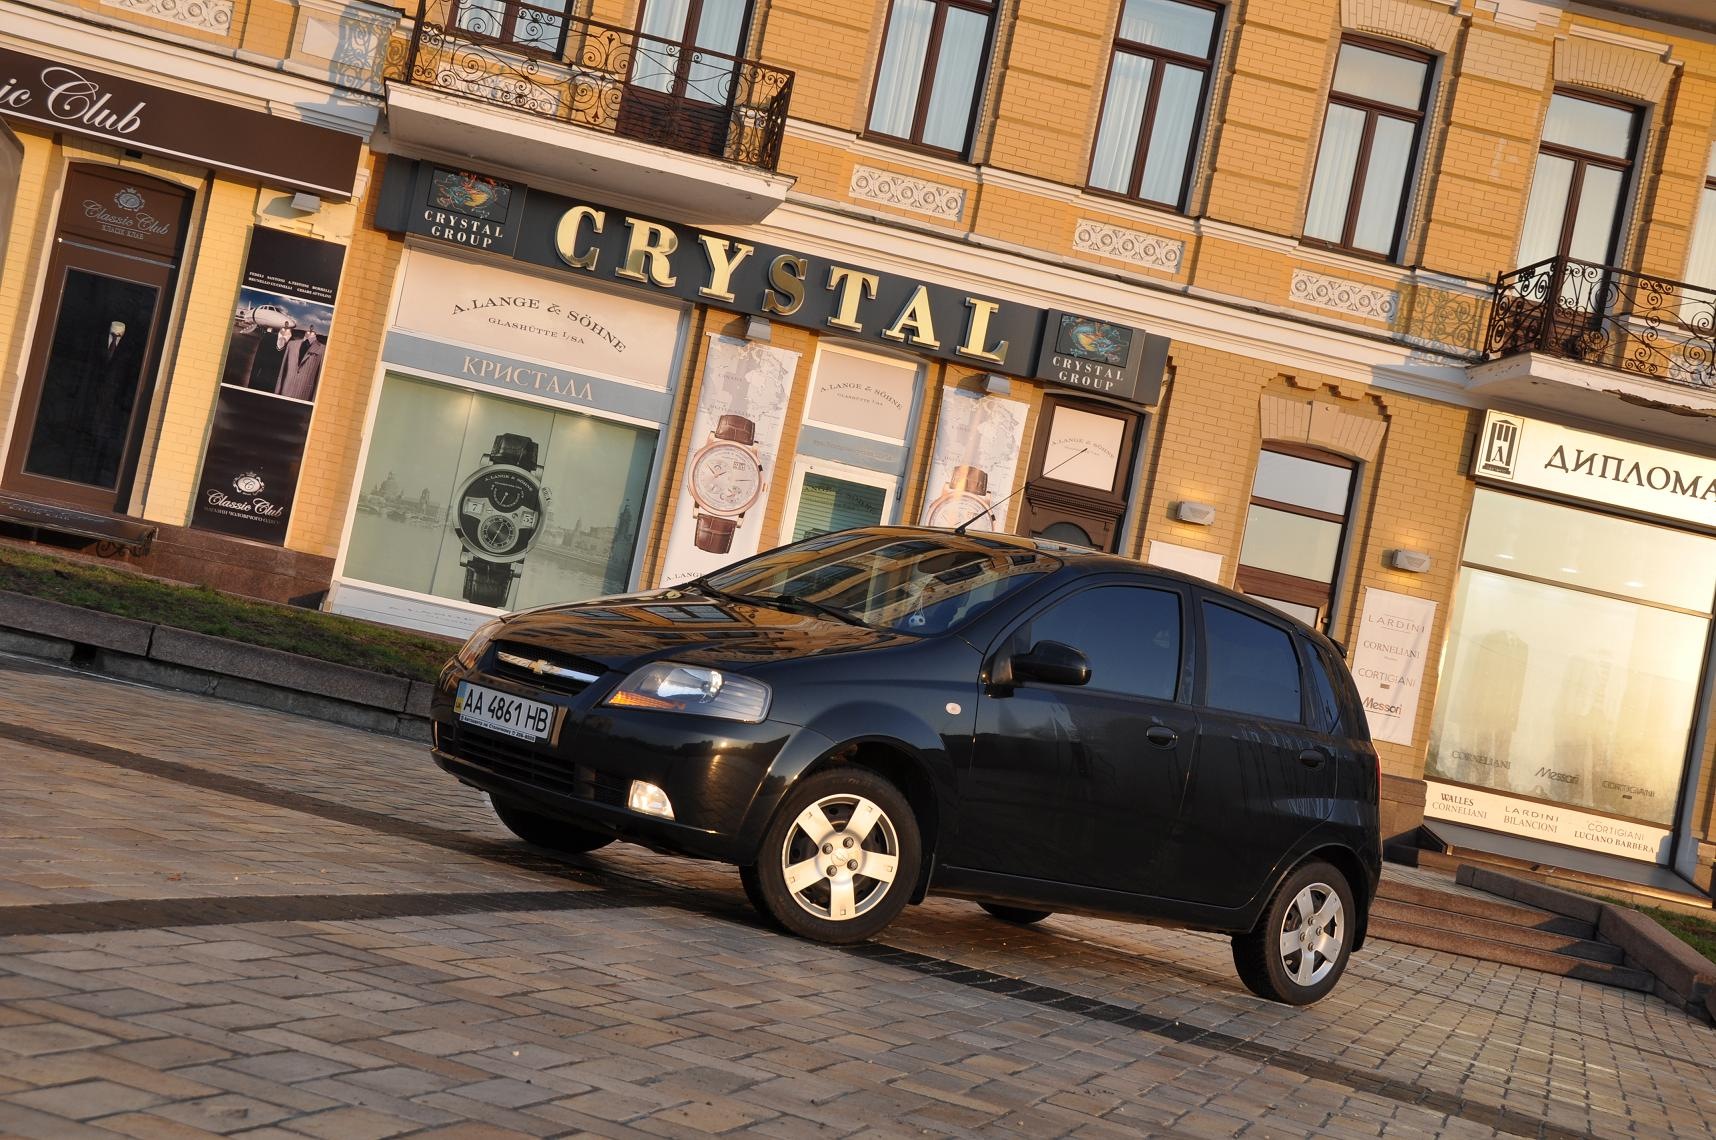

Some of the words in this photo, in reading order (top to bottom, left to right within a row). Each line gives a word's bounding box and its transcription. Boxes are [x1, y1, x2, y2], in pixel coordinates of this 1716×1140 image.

[41, 66, 147, 134] Club
[82, 199, 134, 226] Classic
[136, 212, 171, 235] Club
[424, 209, 505, 239] CRYSTAL
[431, 225, 493, 249] GROUP
[554, 205, 1009, 366] CRYSTAL
[488, 316, 559, 338] GLASHÜTTE
[547, 303, 561, 315] &
[566, 310, 627, 354] SÖHNE
[462, 355, 594, 402] КРИСТАЛЛ
[1052, 355, 1125, 382] CRYSTAL
[1058, 371, 1114, 392] GROUP
[1544, 444, 1716, 504] ДИПЛОМА
[207, 489, 251, 512] Classic
[253, 498, 284, 517] Club
[1368, 614, 1426, 634] LARDINI
[1363, 639, 1421, 659] CORNELIANI
[1357, 667, 1416, 688] CORTIGIANI
[464, 688, 484, 715] AA
[488, 695, 522, 726] 4861
[525, 704, 549, 733] HB
[1362, 696, 1403, 716] Messori
[1451, 750, 1512, 770] CORNELIANI
[1431, 800, 1488, 820] CORNELIANI
[1440, 792, 1474, 808] WALLES
[1503, 815, 1559, 834] BILANCIONI
[1505, 805, 1560, 823] LARDINI
[1573, 829, 1614, 846] LUCIANO
[1615, 837, 1655, 855] BARBERA
[1587, 822, 1645, 842] CORTIGIANI
